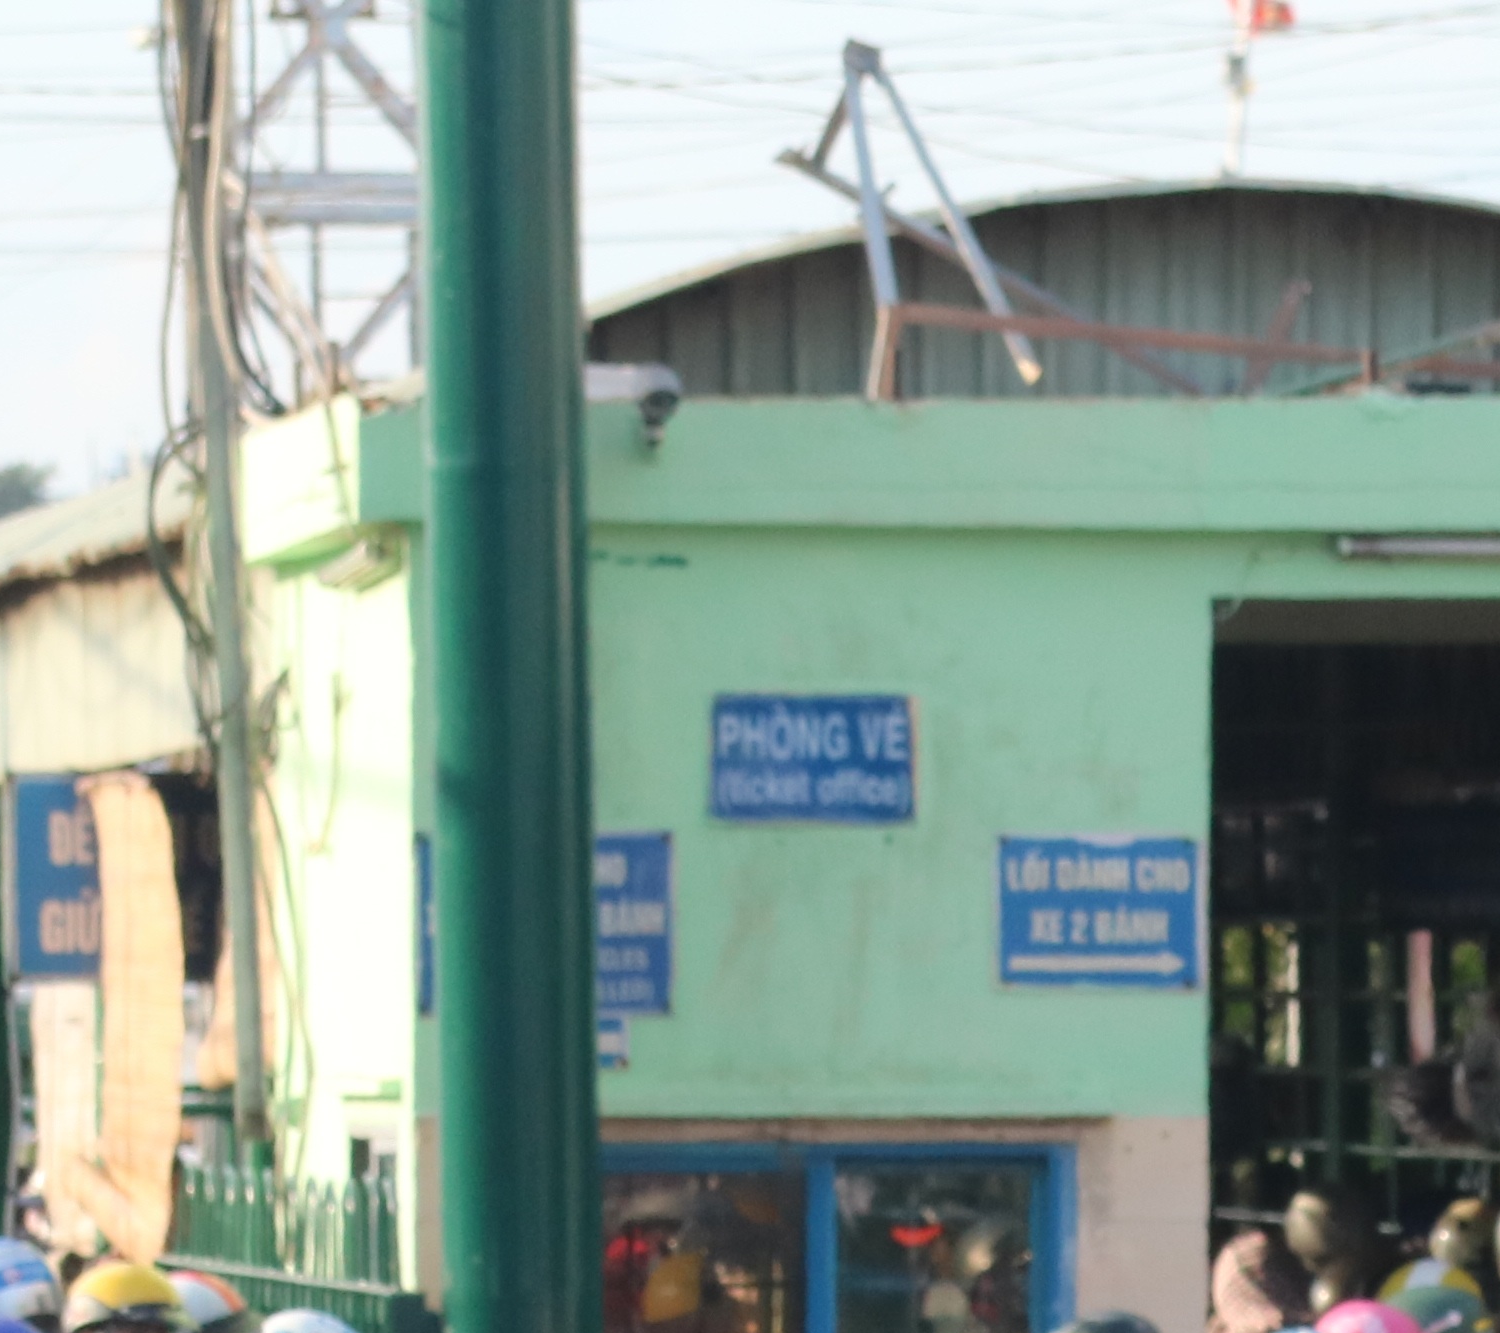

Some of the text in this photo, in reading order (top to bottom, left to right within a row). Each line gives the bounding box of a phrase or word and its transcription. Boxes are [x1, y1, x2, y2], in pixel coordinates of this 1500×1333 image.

[719, 694, 908, 761] PHÒNG VÉ
[1134, 857, 1192, 892] CHO
[1030, 908, 1065, 944] XE
[1070, 910, 1090, 944] 2
